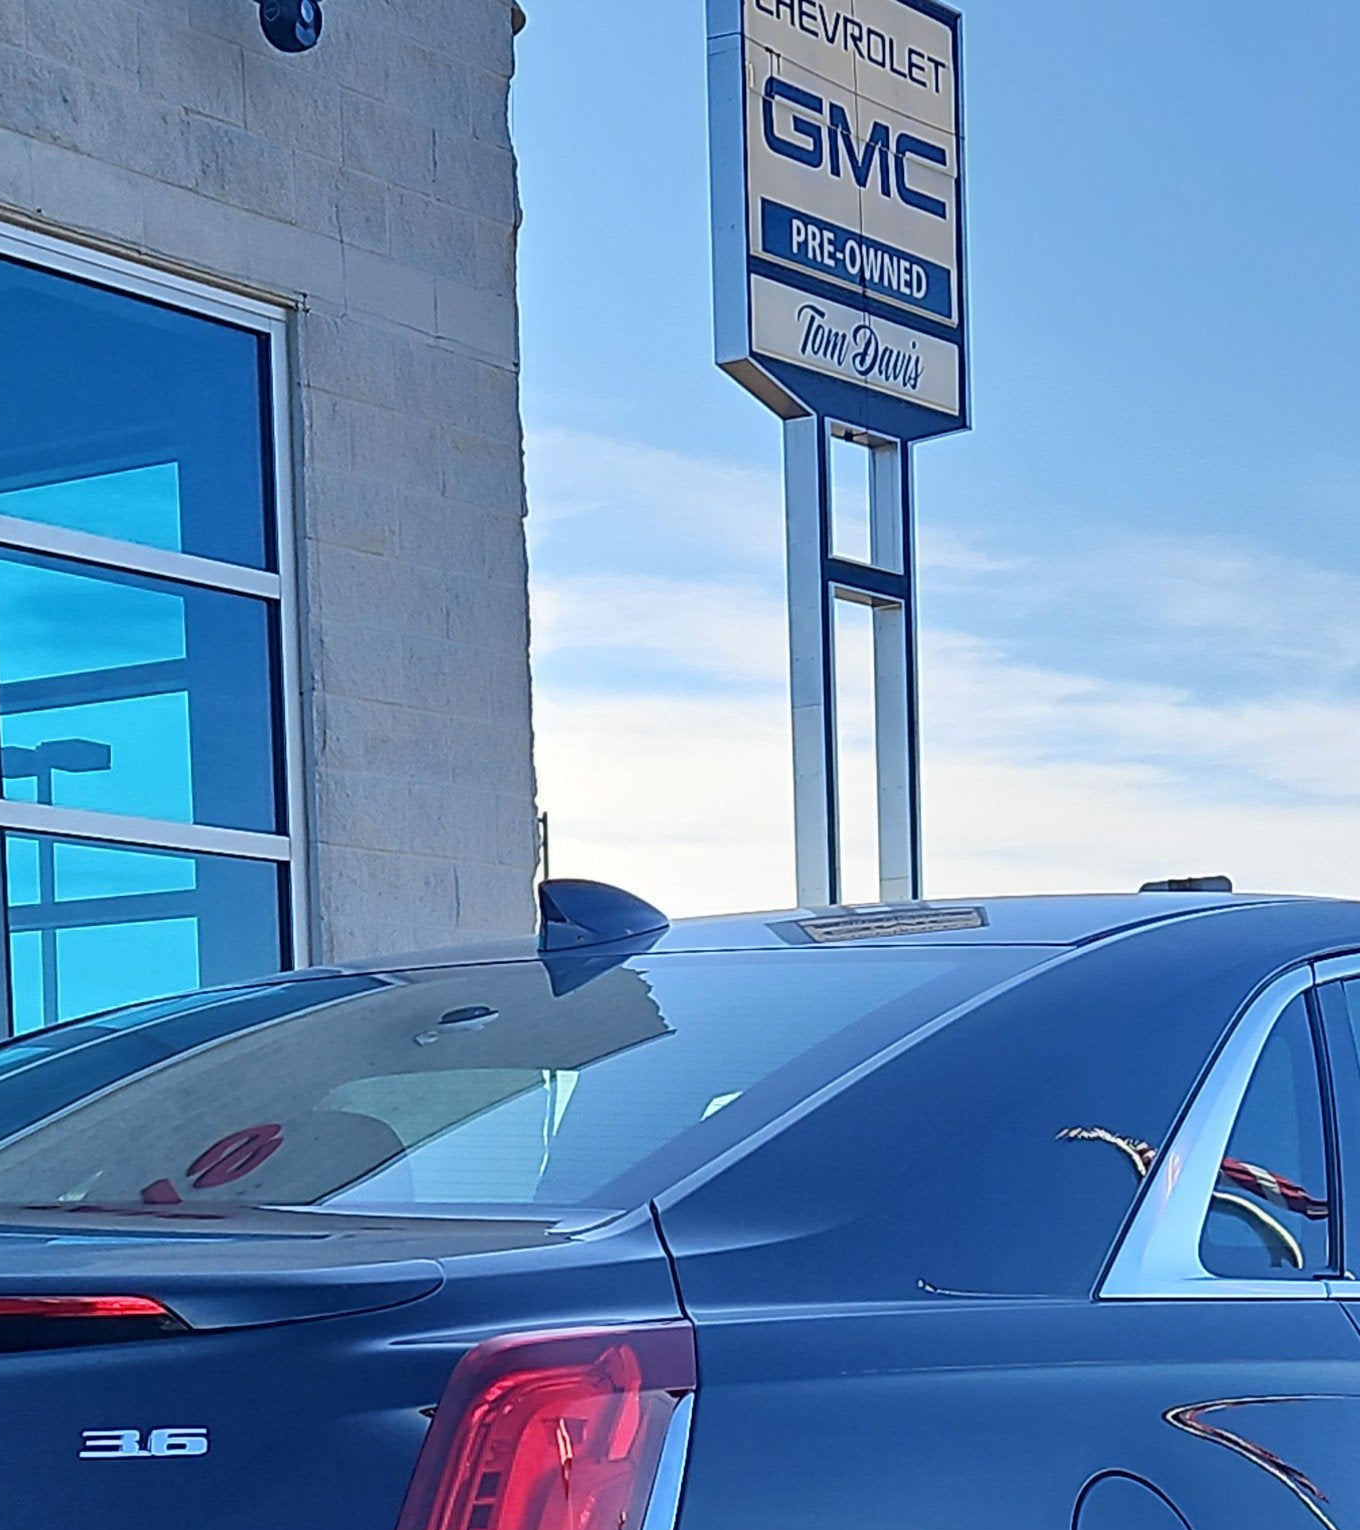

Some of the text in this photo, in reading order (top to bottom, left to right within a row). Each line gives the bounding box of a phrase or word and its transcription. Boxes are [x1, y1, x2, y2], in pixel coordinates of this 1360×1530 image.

[762, 76, 948, 219] GMC
[791, 218, 928, 300] PRE-OWNED
[797, 304, 925, 391] Tom Davis
[79, 1428, 208, 1458] 3.6
